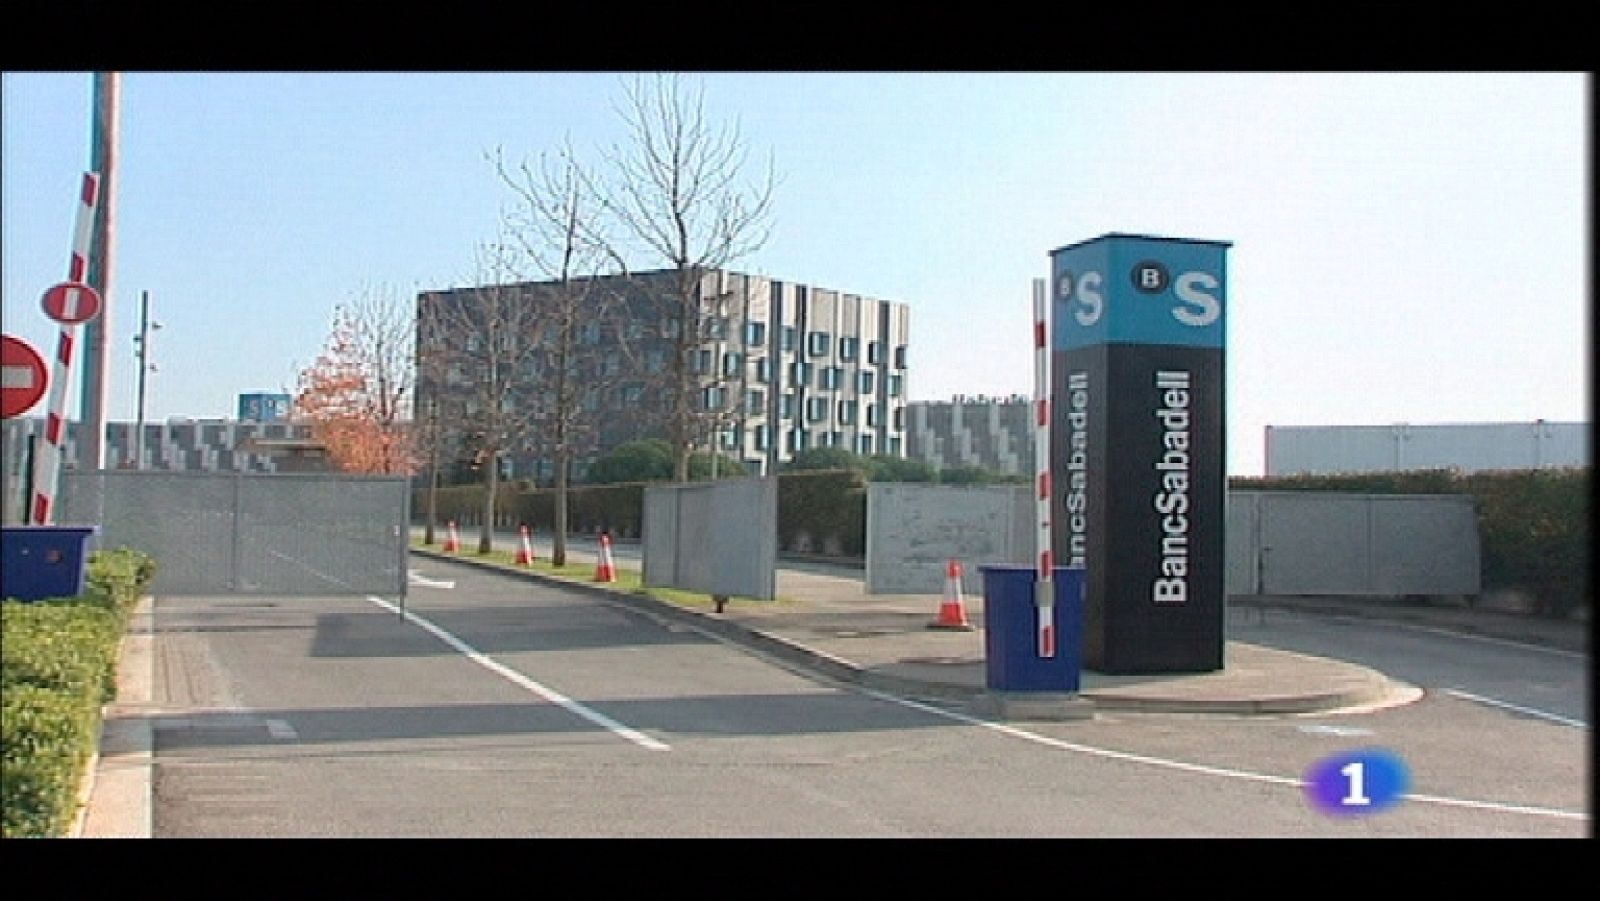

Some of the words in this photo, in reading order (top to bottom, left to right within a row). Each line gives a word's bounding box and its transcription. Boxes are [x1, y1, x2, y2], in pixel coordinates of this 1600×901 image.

[1074, 271, 1103, 327] S
[1141, 268, 1160, 288] B
[1171, 271, 1221, 327] S
[1154, 370, 1189, 602] BancSabadell
